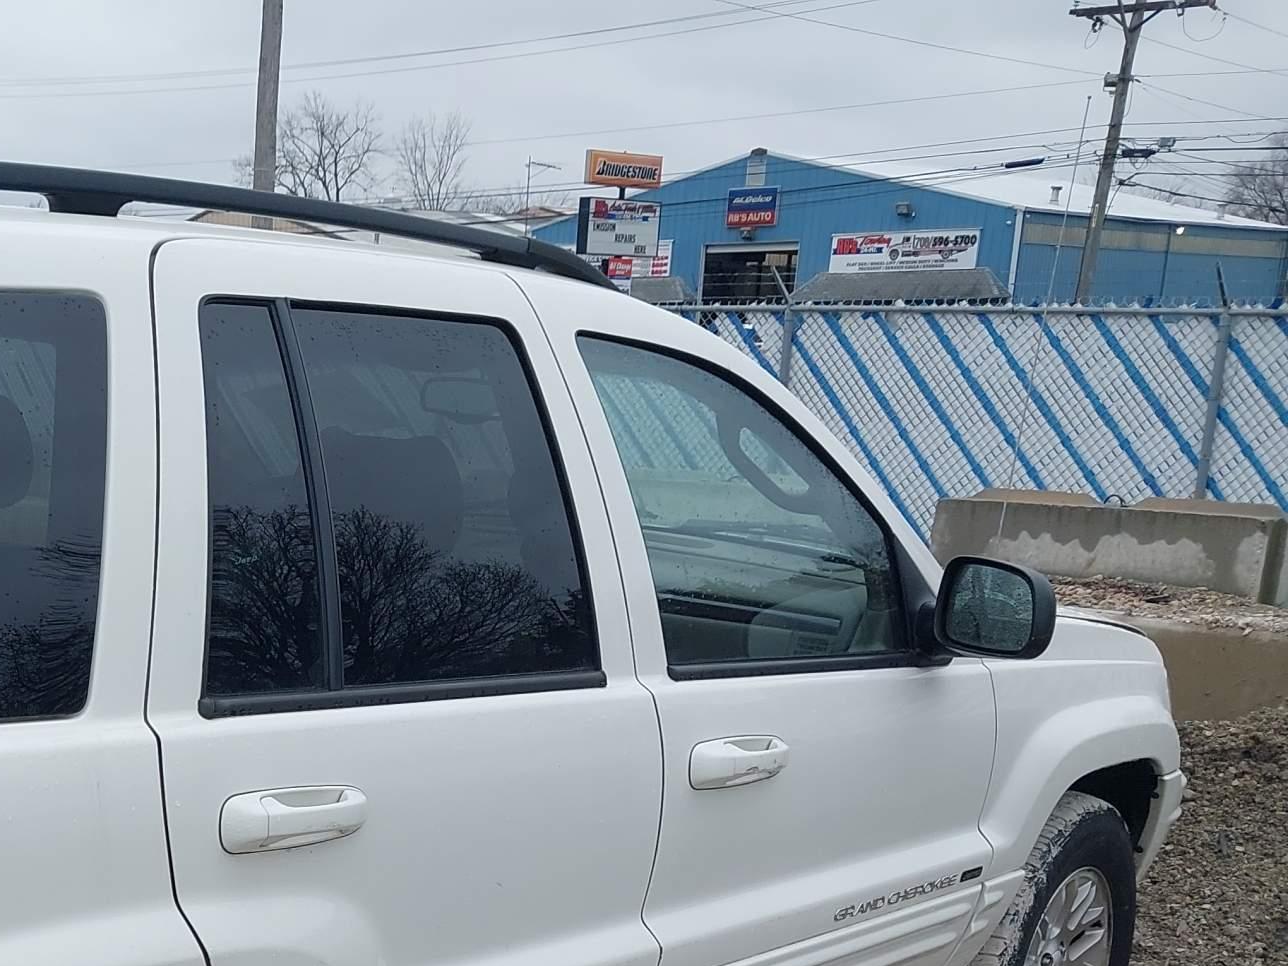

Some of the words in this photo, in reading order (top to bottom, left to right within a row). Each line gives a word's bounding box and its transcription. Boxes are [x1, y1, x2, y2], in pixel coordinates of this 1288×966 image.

[596, 160, 658, 180] BRIDGESTONE
[747, 211, 772, 222] AUTO
[592, 222, 616, 232] EMISSION
[614, 233, 636, 243] REPAIRS
[634, 245, 646, 254] HERE
[834, 896, 885, 921] GRAND
[887, 873, 958, 905] CHEROKEE
